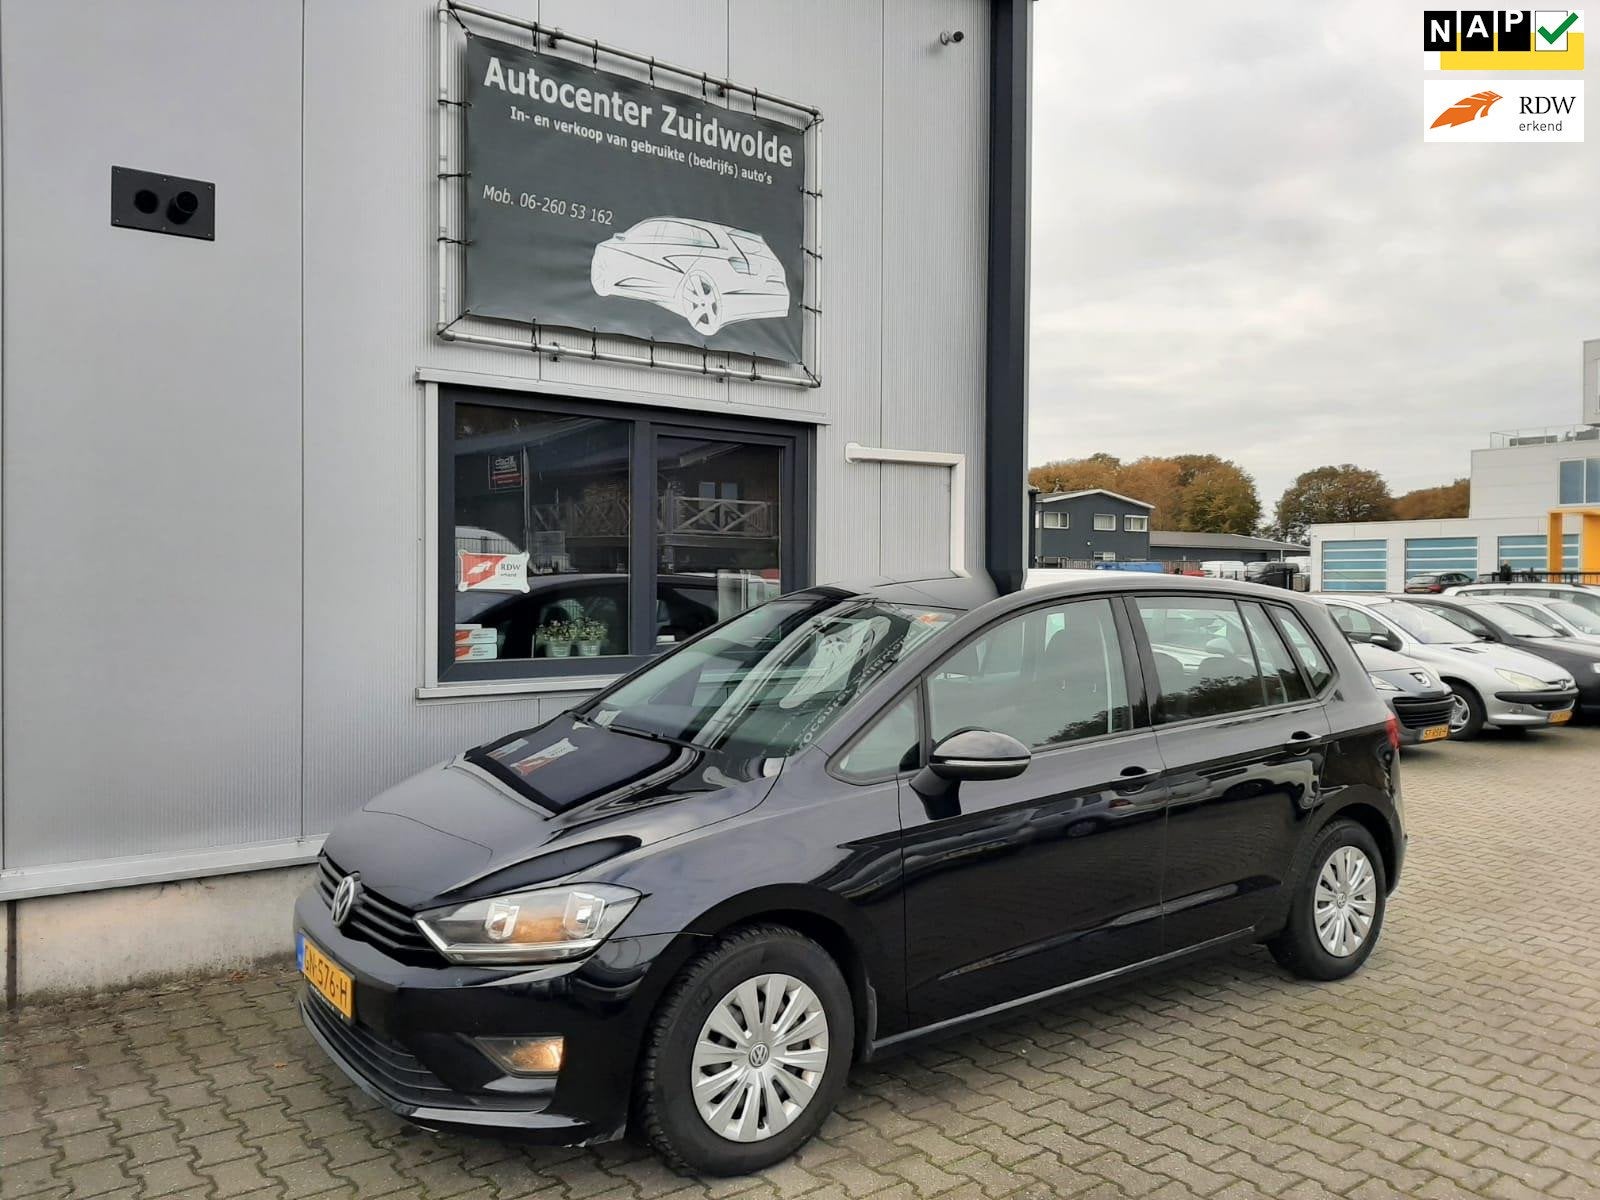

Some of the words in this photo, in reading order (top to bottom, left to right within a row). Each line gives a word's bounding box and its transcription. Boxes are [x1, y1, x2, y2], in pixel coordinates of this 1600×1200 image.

[484, 56, 652, 128] Autocenter
[661, 104, 793, 167] Zuidwolde
[510, 106, 530, 122] In-
[534, 114, 549, 128] en
[553, 119, 603, 143] verkoop
[607, 132, 627, 147] van
[630, 139, 685, 162] gebruikte
[688, 151, 738, 178] (bedrijfs)
[741, 167, 772, 184] auto's
[483, 184, 514, 205] Mob.
[520, 192, 566, 216] 06-260
[570, 203, 586, 219] 53
[590, 208, 613, 225] 162
